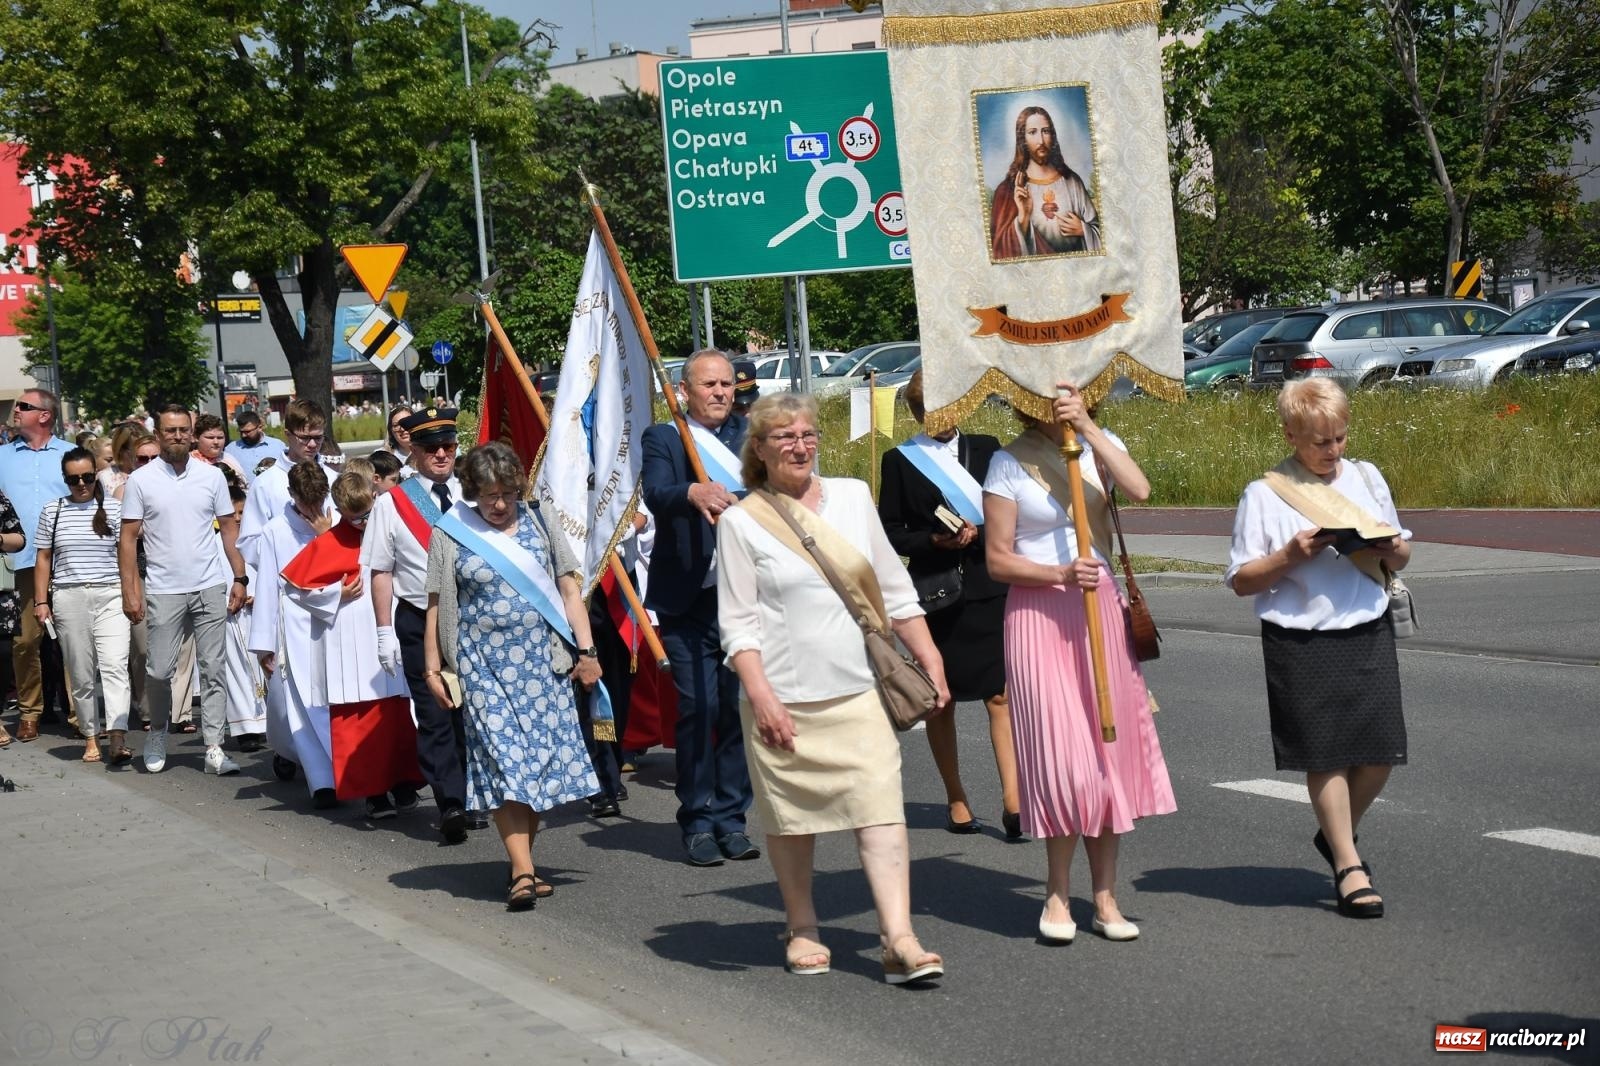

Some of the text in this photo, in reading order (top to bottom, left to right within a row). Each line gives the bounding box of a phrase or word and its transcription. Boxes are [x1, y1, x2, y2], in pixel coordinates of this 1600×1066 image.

[667, 67, 736, 93] Opole
[671, 98, 783, 120] Pietraszyn
[672, 129, 747, 153] Opava
[798, 139, 813, 152] 4t
[845, 130, 874, 148] 3,5t
[674, 155, 777, 180] Chałupki
[677, 189, 765, 209] Ostrava
[881, 206, 905, 223] 3,5
[1062, 321, 1084, 337] NAD
[1084, 305, 1111, 327] NAMI
